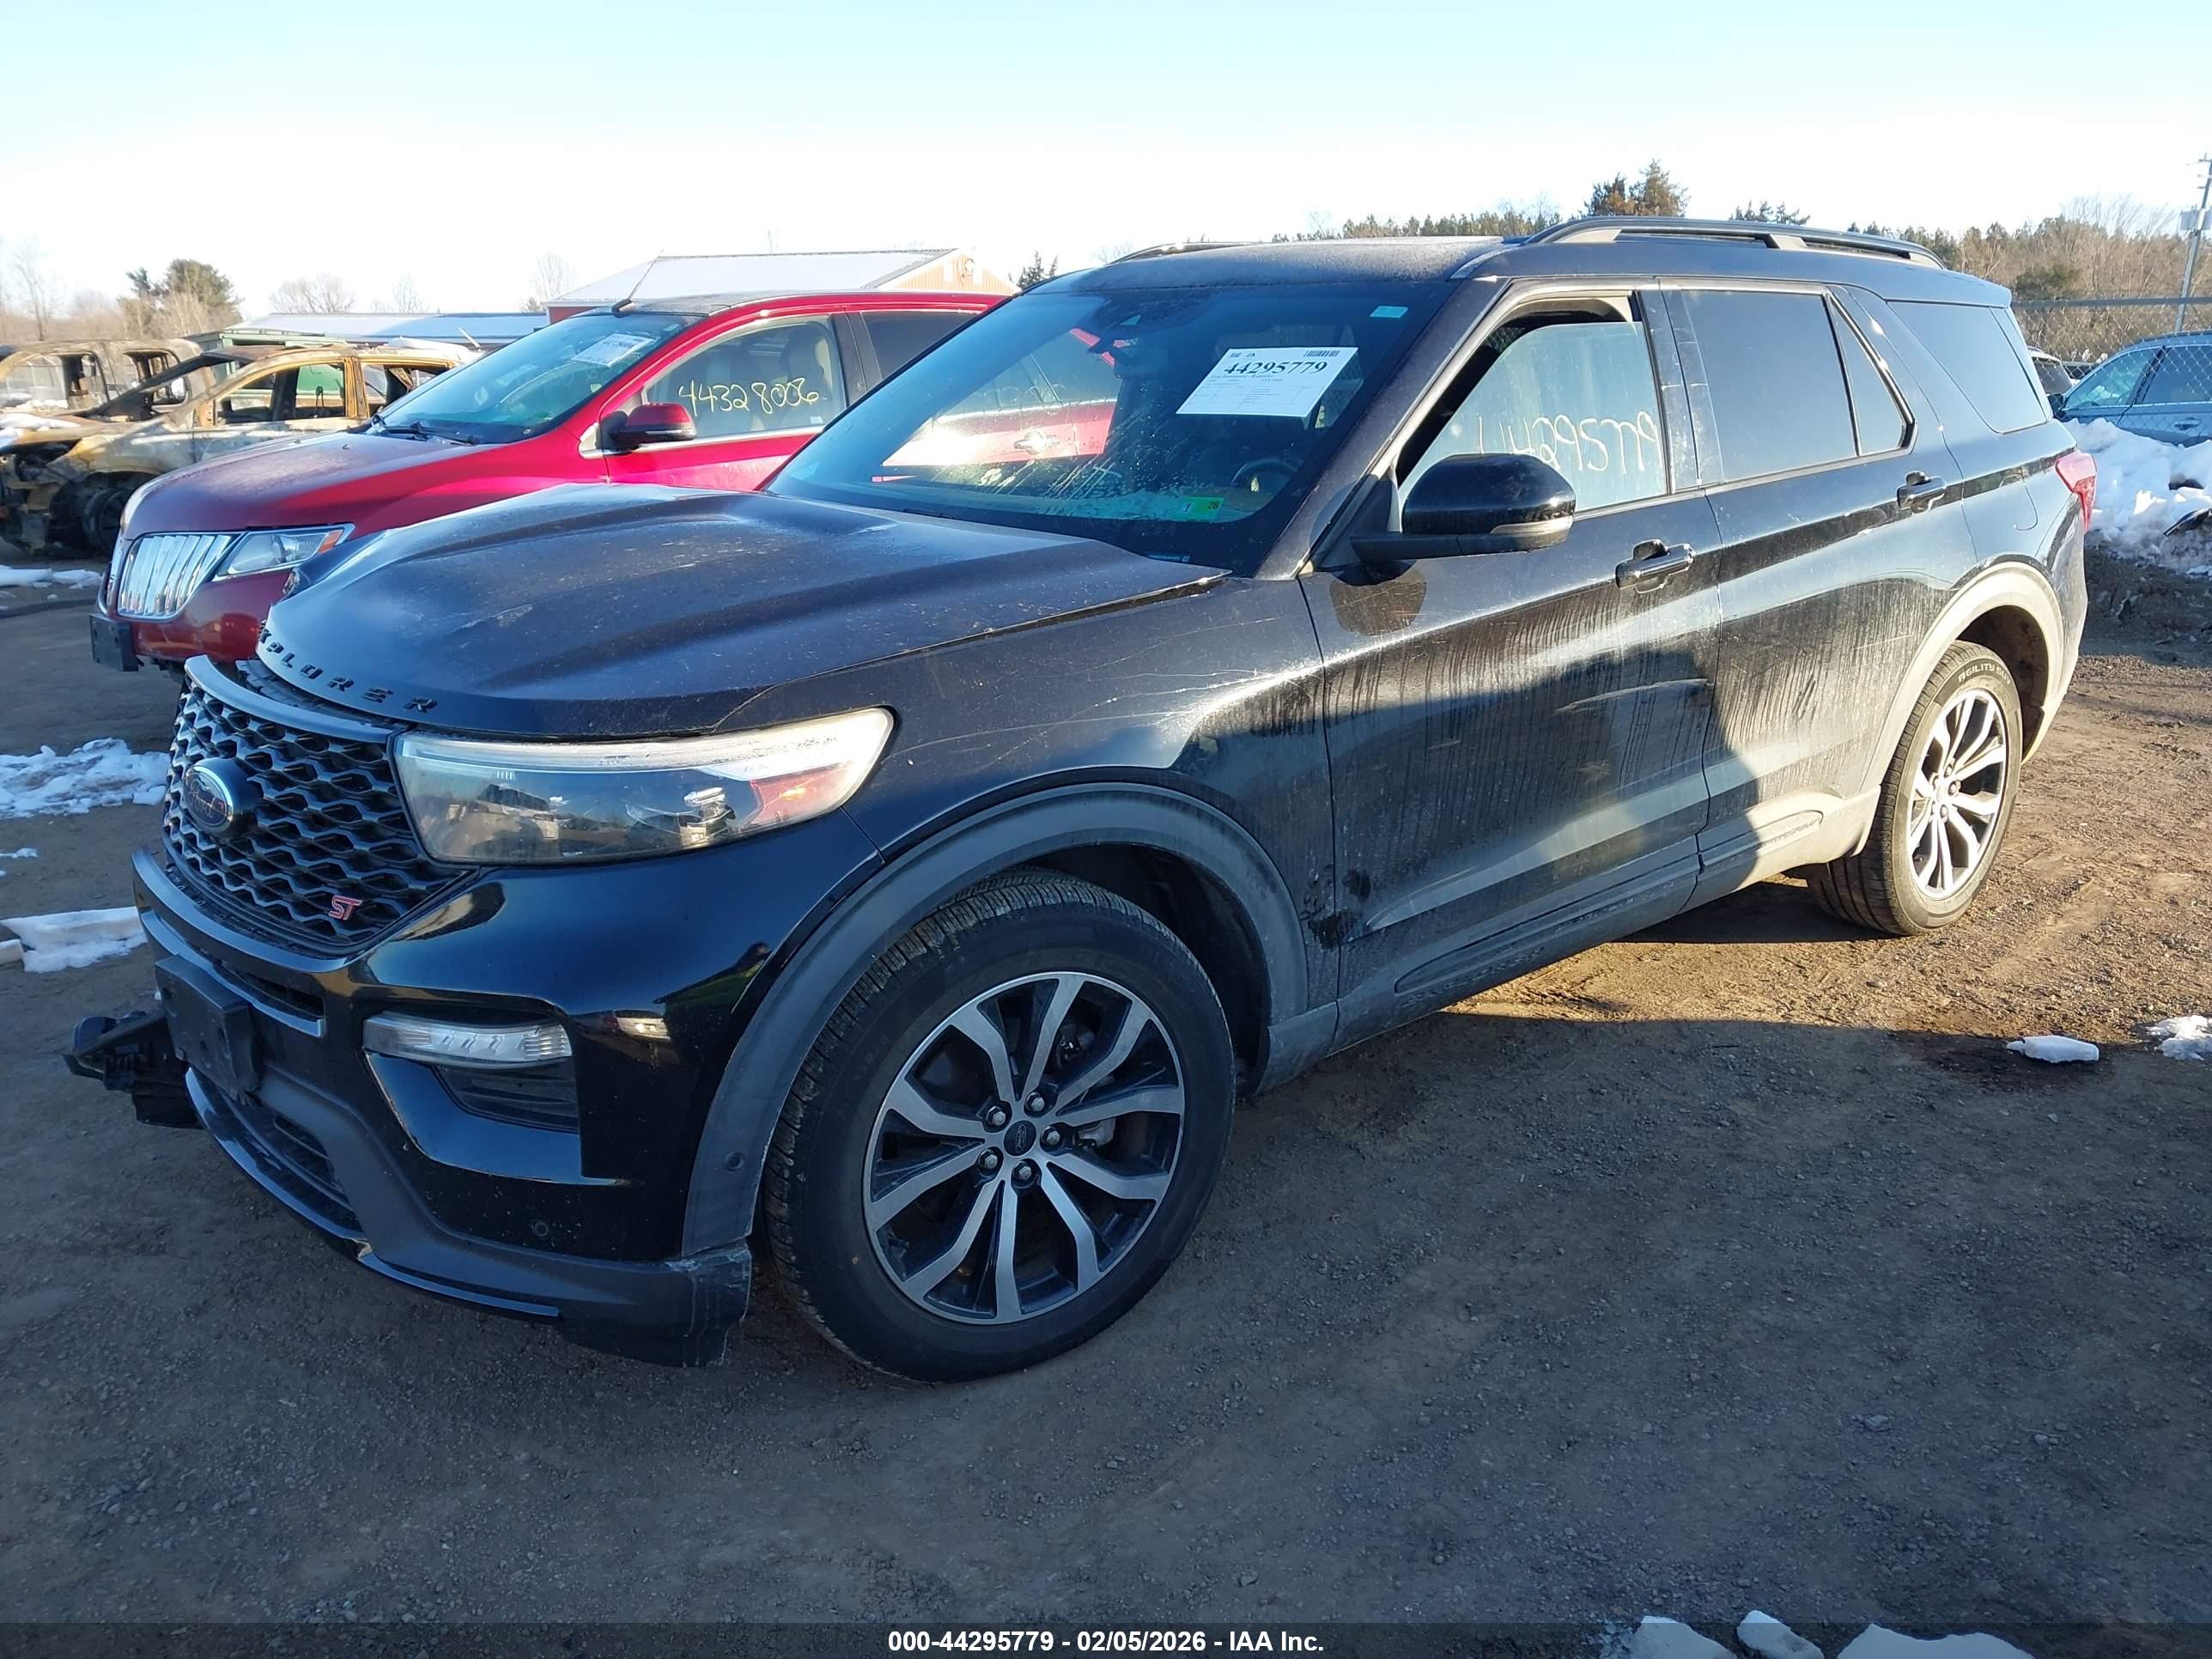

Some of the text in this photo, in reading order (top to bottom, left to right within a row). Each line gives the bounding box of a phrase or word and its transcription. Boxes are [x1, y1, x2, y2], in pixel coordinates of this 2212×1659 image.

[1224, 361, 1328, 374] 44295779
[678, 378, 820, 418] 44328006
[1958, 663, 1996, 684] AGILITY
[328, 896, 362, 921] ST
